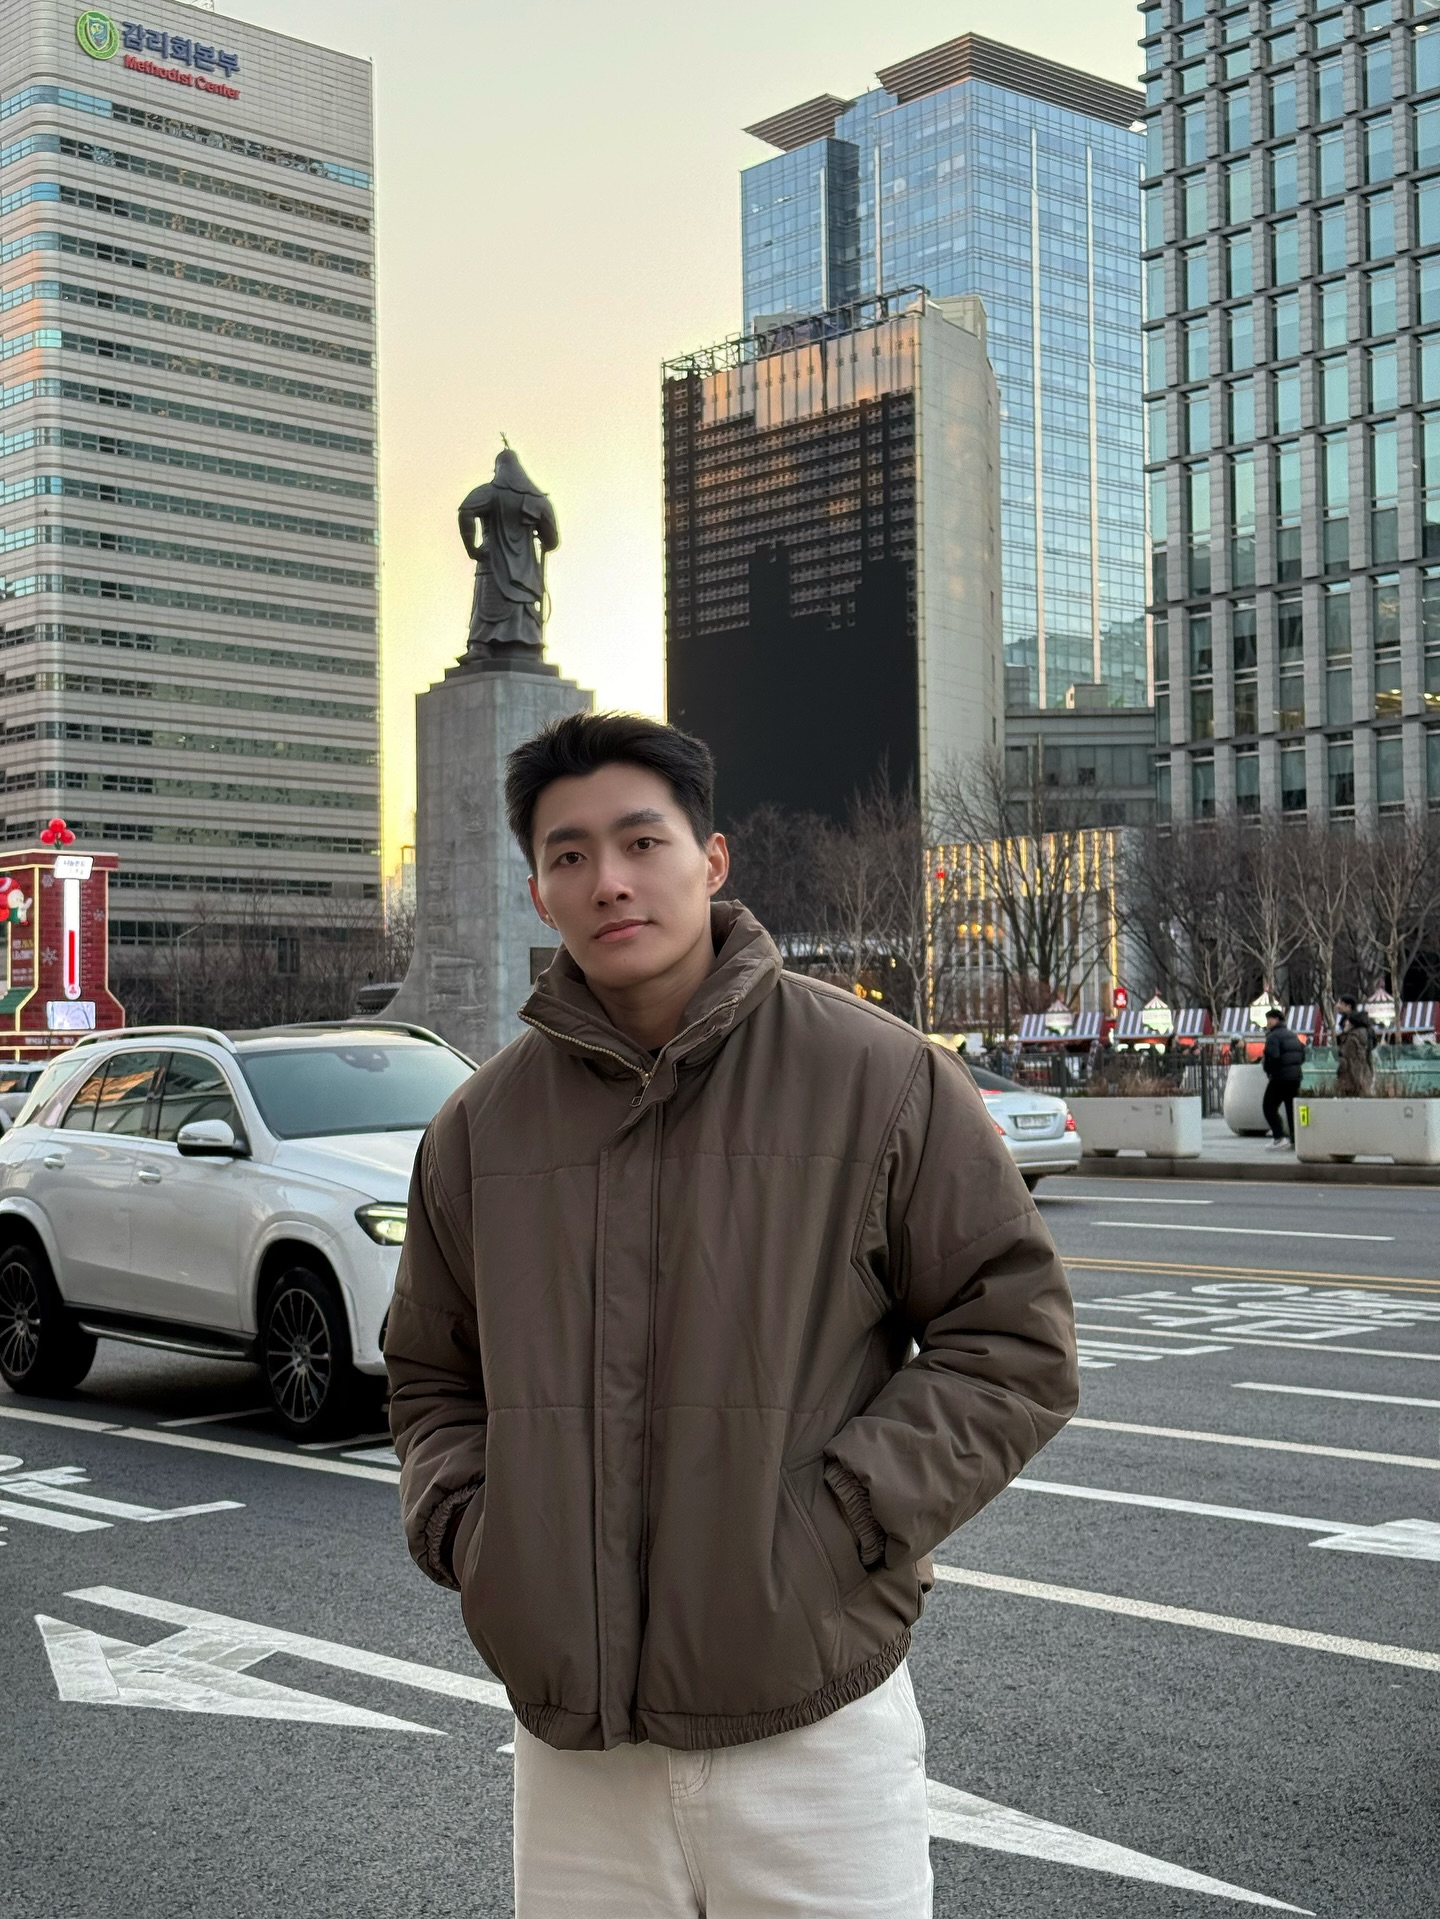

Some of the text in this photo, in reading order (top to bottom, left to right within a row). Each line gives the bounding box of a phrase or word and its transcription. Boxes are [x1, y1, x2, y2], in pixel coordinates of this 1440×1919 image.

[122, 21, 240, 78] 감리회본부
[123, 54, 241, 100] Methodist Center
